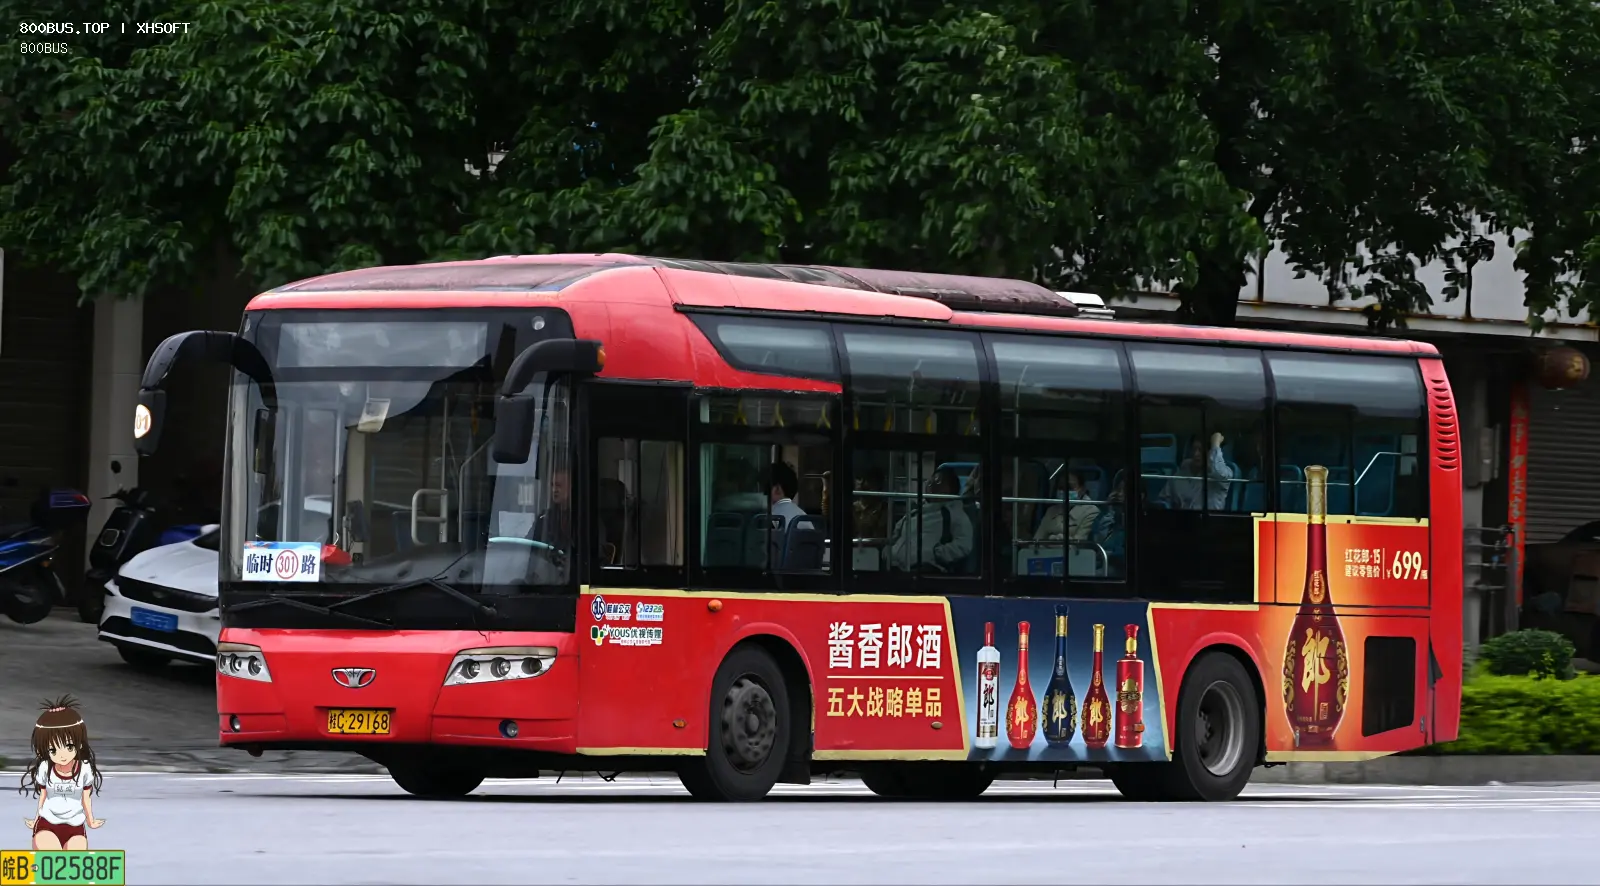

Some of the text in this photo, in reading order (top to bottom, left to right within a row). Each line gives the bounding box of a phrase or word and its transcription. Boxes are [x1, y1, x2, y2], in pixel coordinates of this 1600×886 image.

[246, 553, 316, 575] 临时 301 路
[827, 621, 942, 670] 酱香郎酒
[826, 686, 942, 718] 五大战略单品
